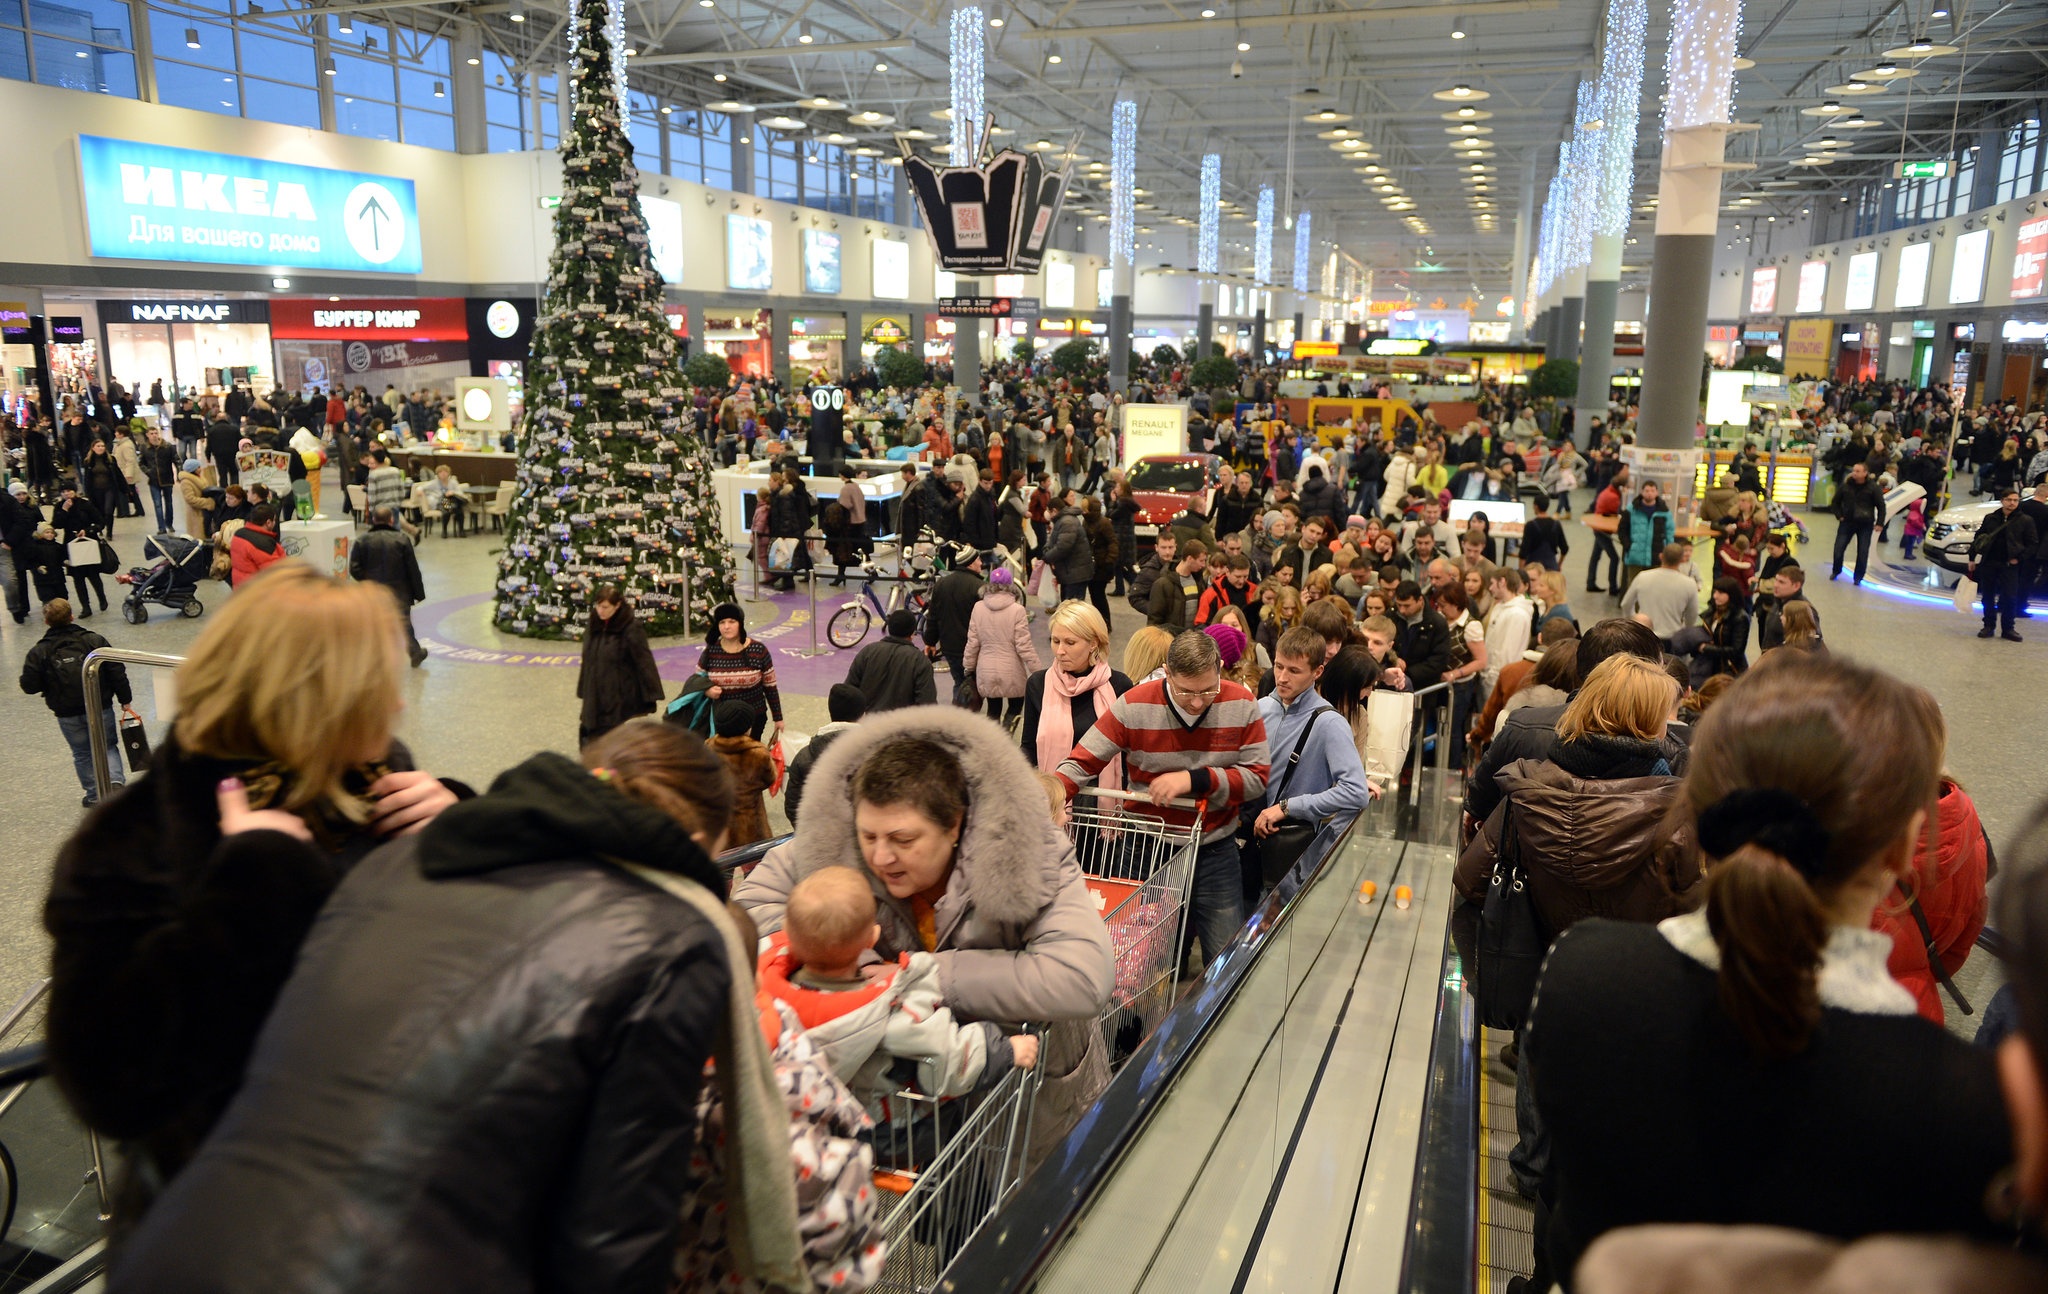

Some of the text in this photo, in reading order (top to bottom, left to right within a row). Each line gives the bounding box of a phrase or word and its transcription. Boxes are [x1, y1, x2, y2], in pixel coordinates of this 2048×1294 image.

[119, 163, 318, 221] ИКЕА
[128, 215, 321, 253] Для вашего дома
[313, 310, 421, 328] БУРГЕР КИНГ
[1132, 419, 1175, 429] RENAULT
[528, 656, 582, 665] МЕГ
